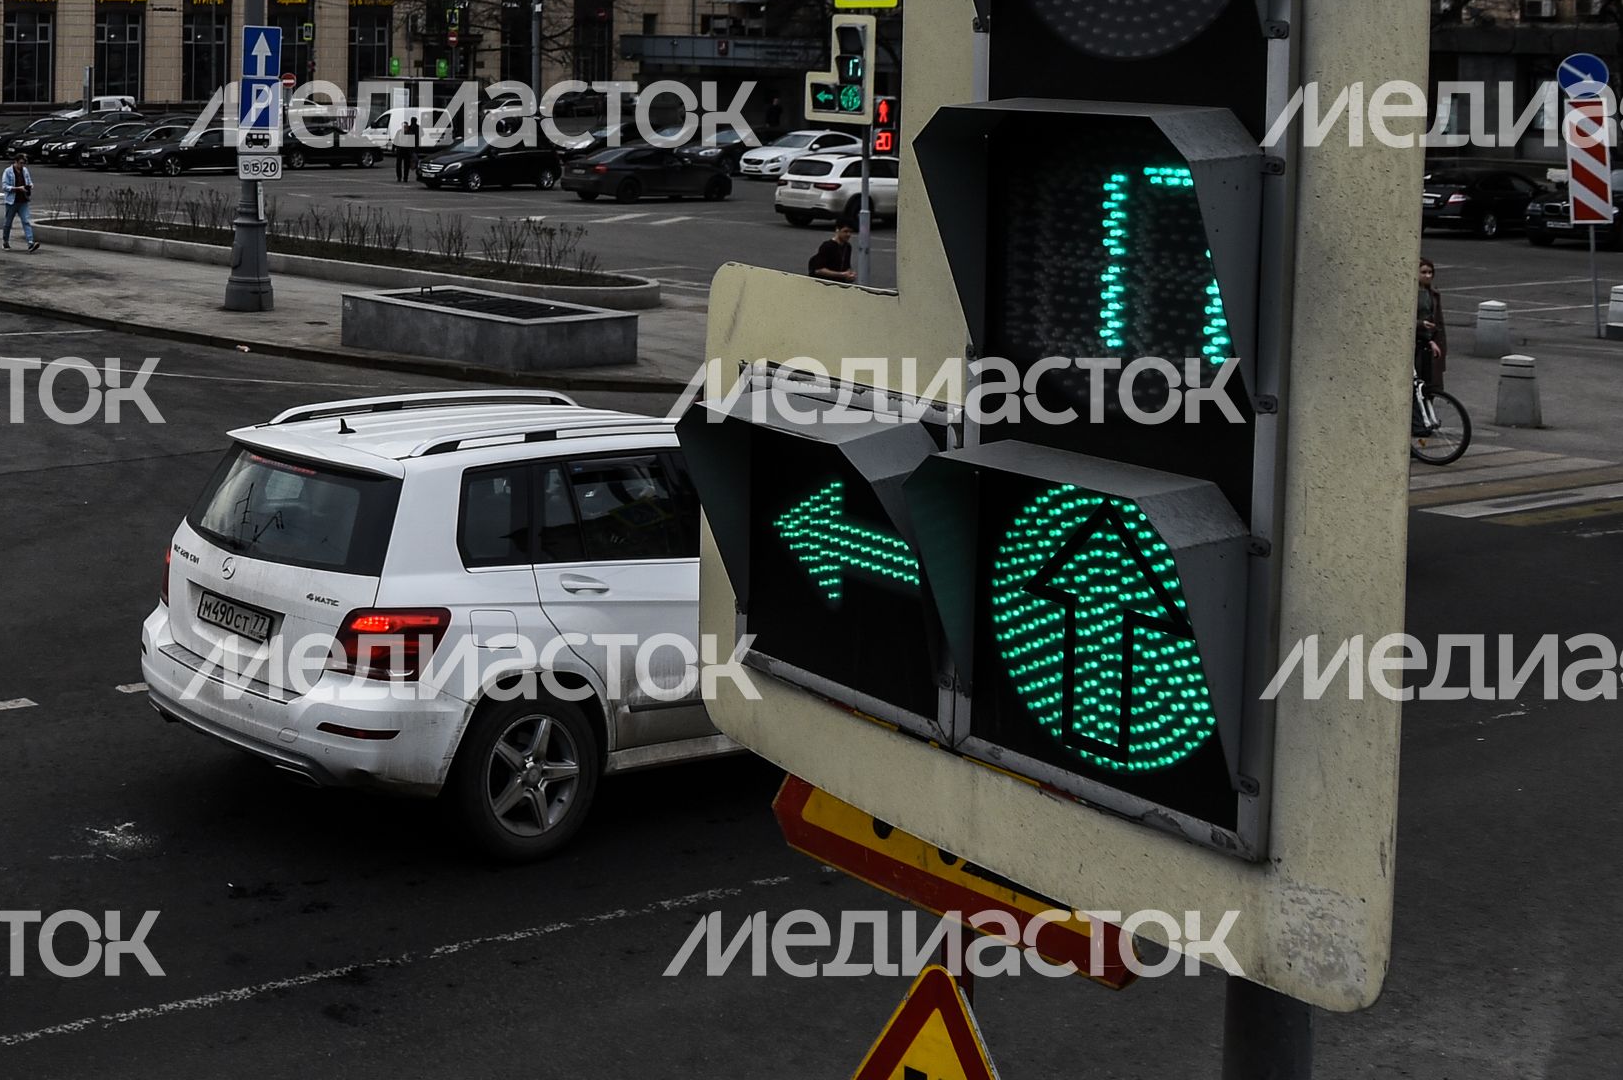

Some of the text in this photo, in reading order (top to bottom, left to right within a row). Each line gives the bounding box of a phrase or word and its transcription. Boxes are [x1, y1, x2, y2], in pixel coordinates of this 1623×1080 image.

[874, 131, 893, 151] 20
[251, 162, 260, 172] 15
[262, 161, 277, 173] 20
[253, 614, 267, 632] 77
